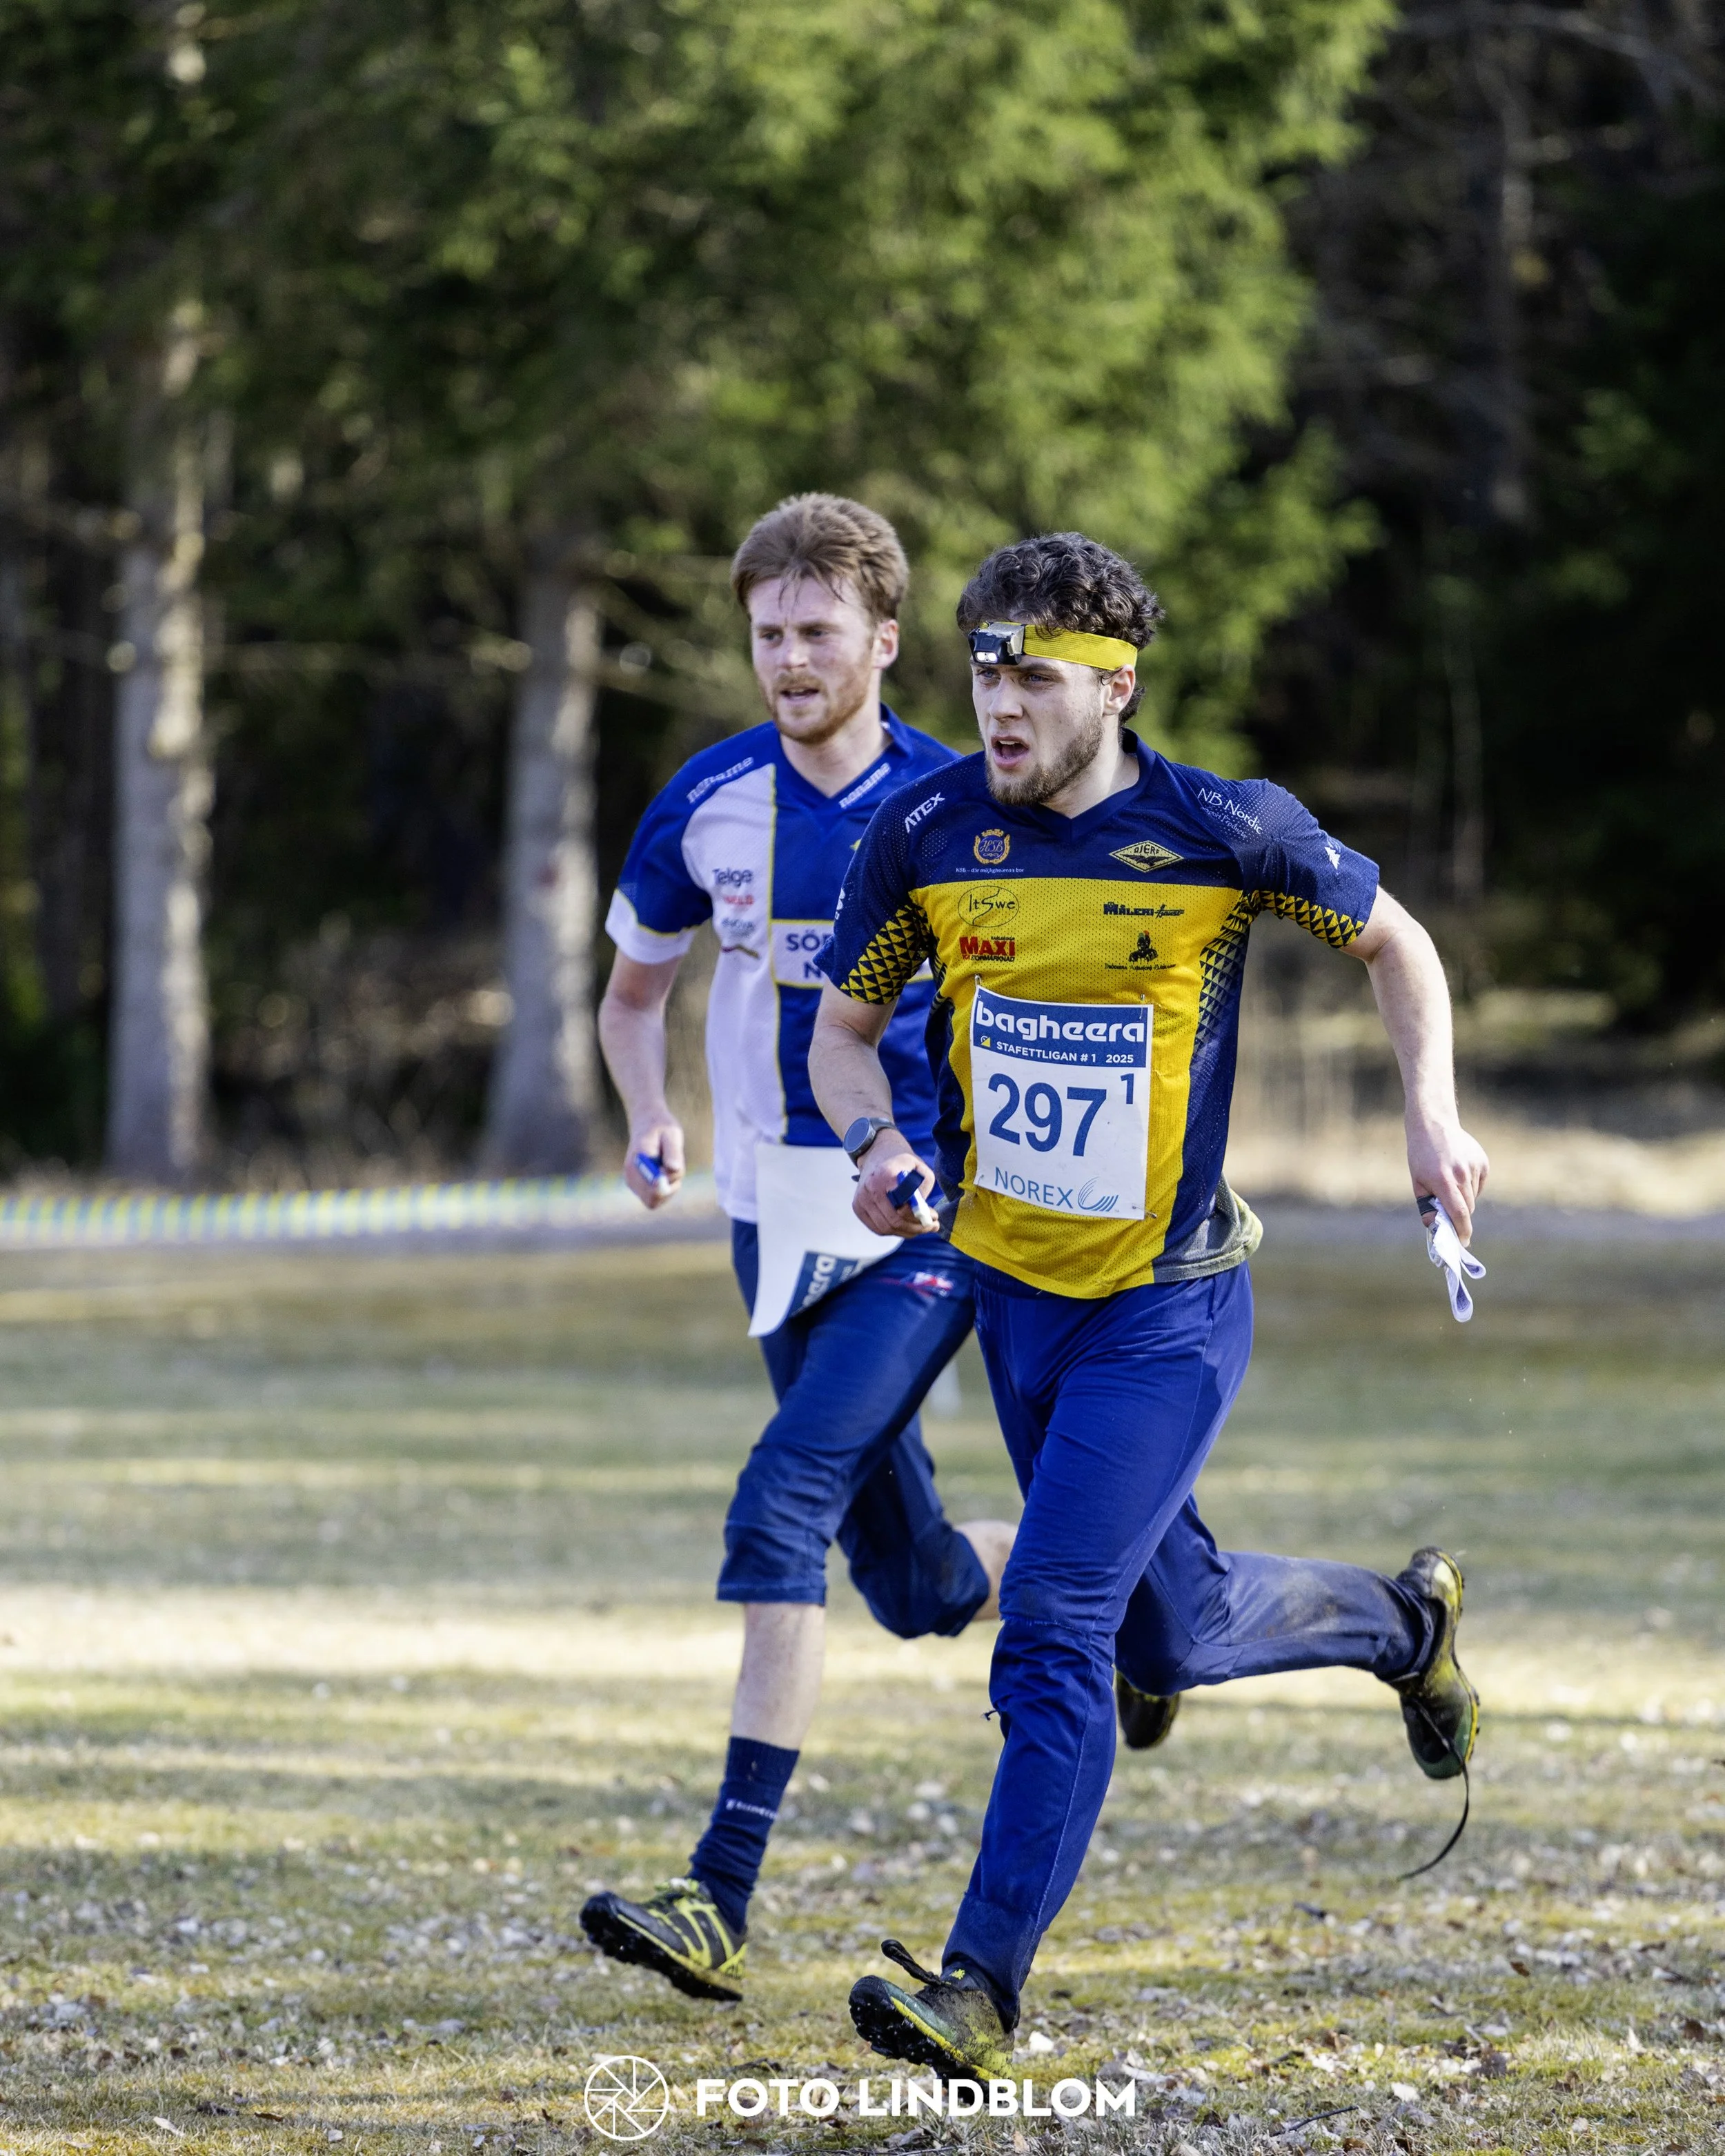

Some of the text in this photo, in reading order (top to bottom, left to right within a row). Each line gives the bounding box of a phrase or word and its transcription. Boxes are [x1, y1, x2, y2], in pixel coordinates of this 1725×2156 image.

[905, 792, 945, 833] ATEX
[1197, 788, 1263, 834] NB Nordic
[712, 867, 752, 888] Telge
[959, 936, 1016, 956] MAXI
[976, 1000, 1145, 1042] bagheera
[996, 1041, 1077, 1062] STAFETTLIGAN
[1105, 1054, 1134, 1063] 2025
[987, 1073, 1134, 1157] 297 1
[994, 1166, 1074, 1209] NOREX
